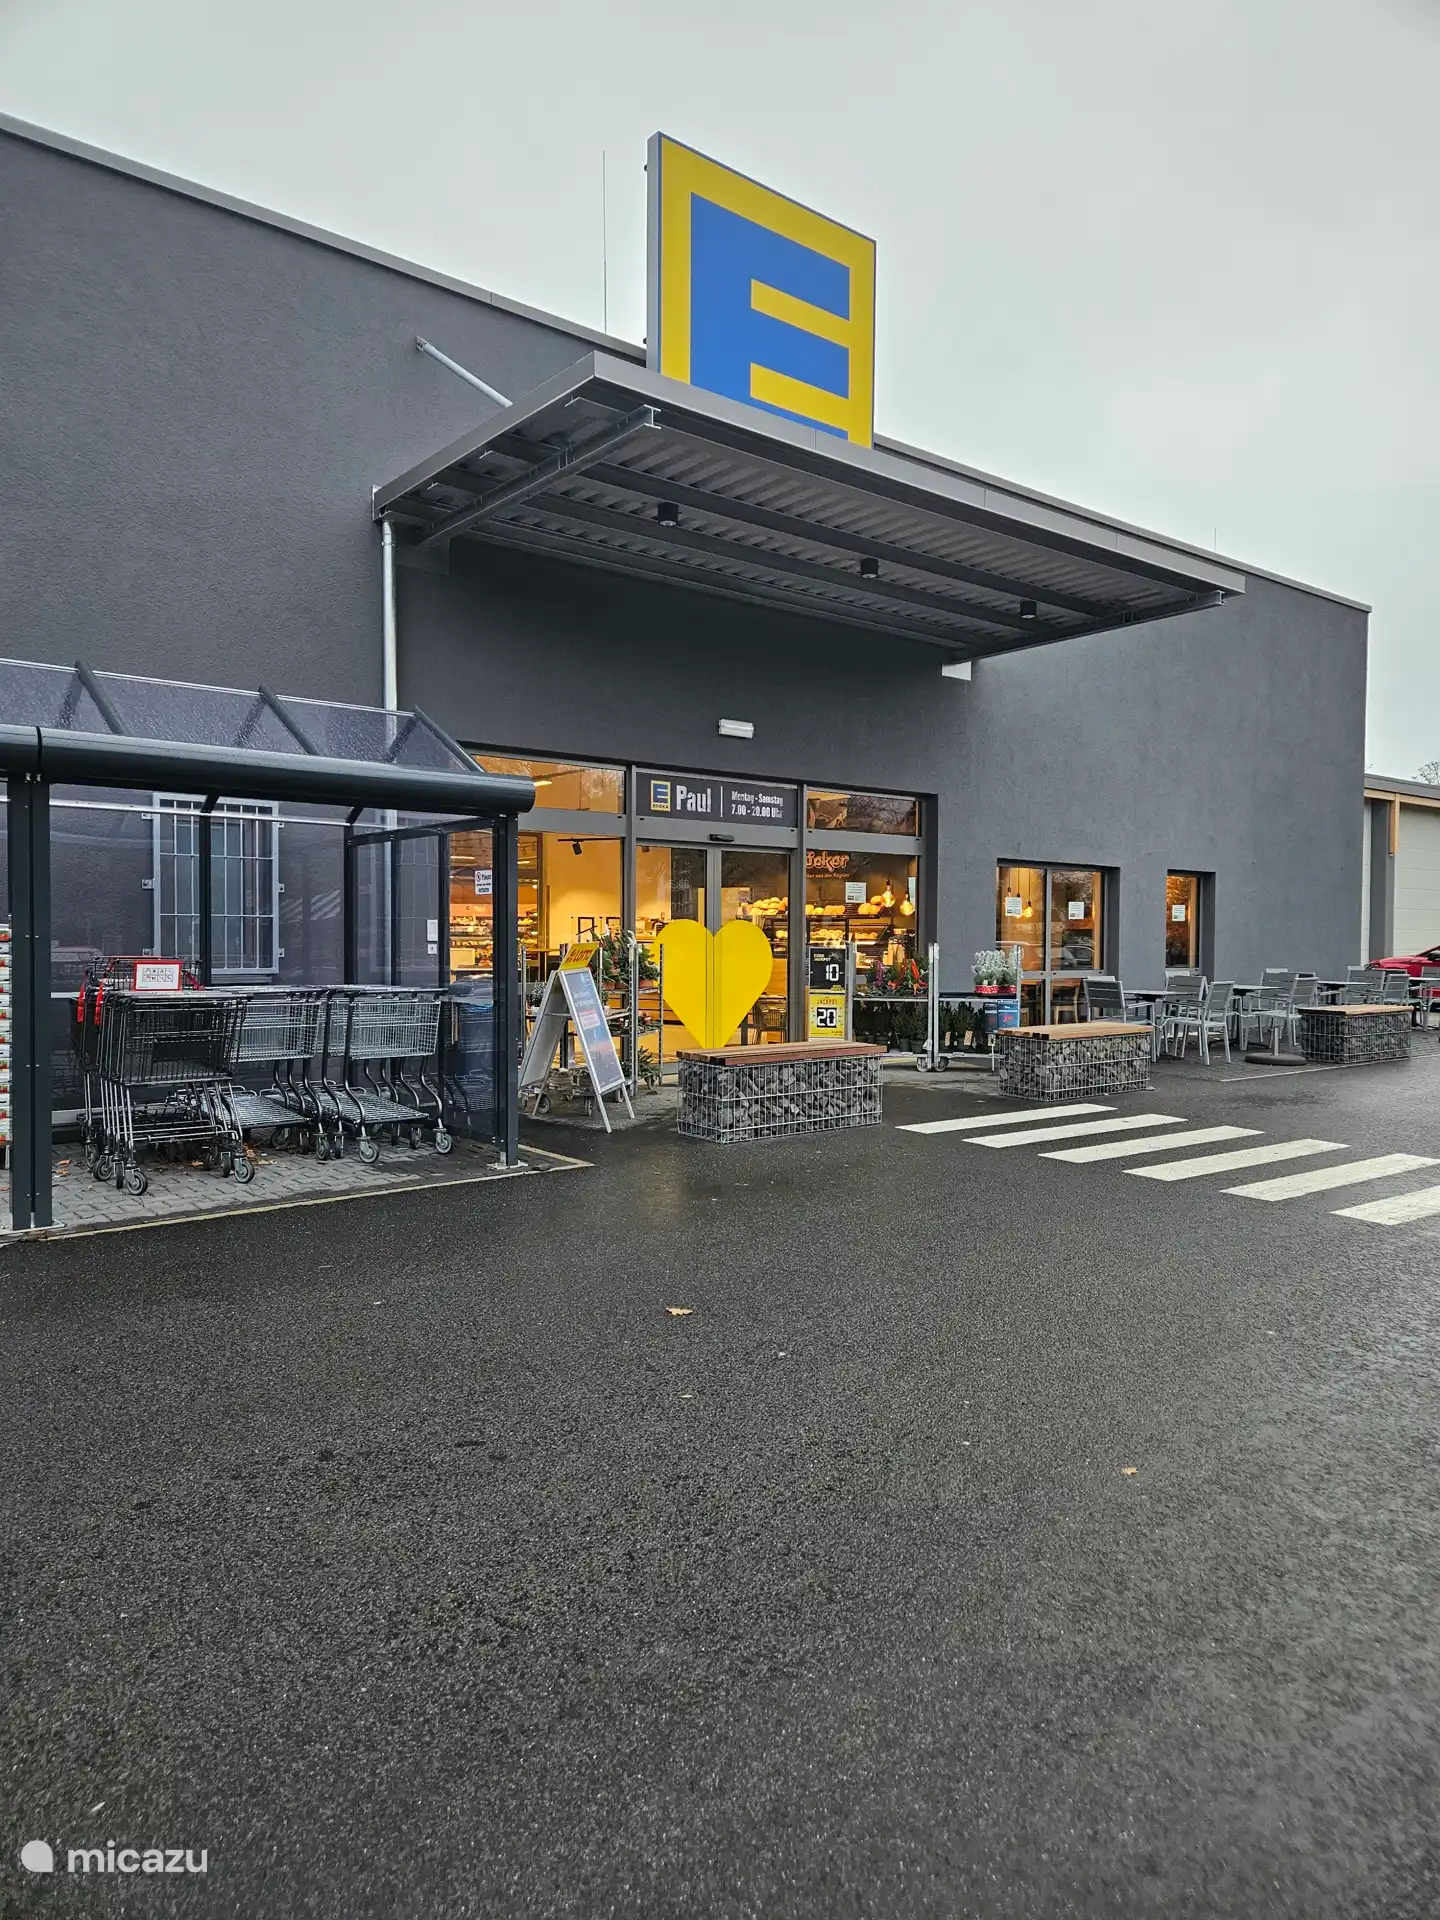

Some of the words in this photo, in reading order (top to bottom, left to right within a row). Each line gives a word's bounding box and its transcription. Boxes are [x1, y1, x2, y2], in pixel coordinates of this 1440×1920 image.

[676, 785, 712, 813] Paul
[731, 790, 755, 804] Montag
[758, 793, 784, 806] Samstag
[731, 804, 747, 816] 7.00
[751, 806, 771, 818] 20.00
[771, 808, 784, 819] Uhr
[825, 963, 840, 981] 10
[817, 1008, 836, 1027] 20
